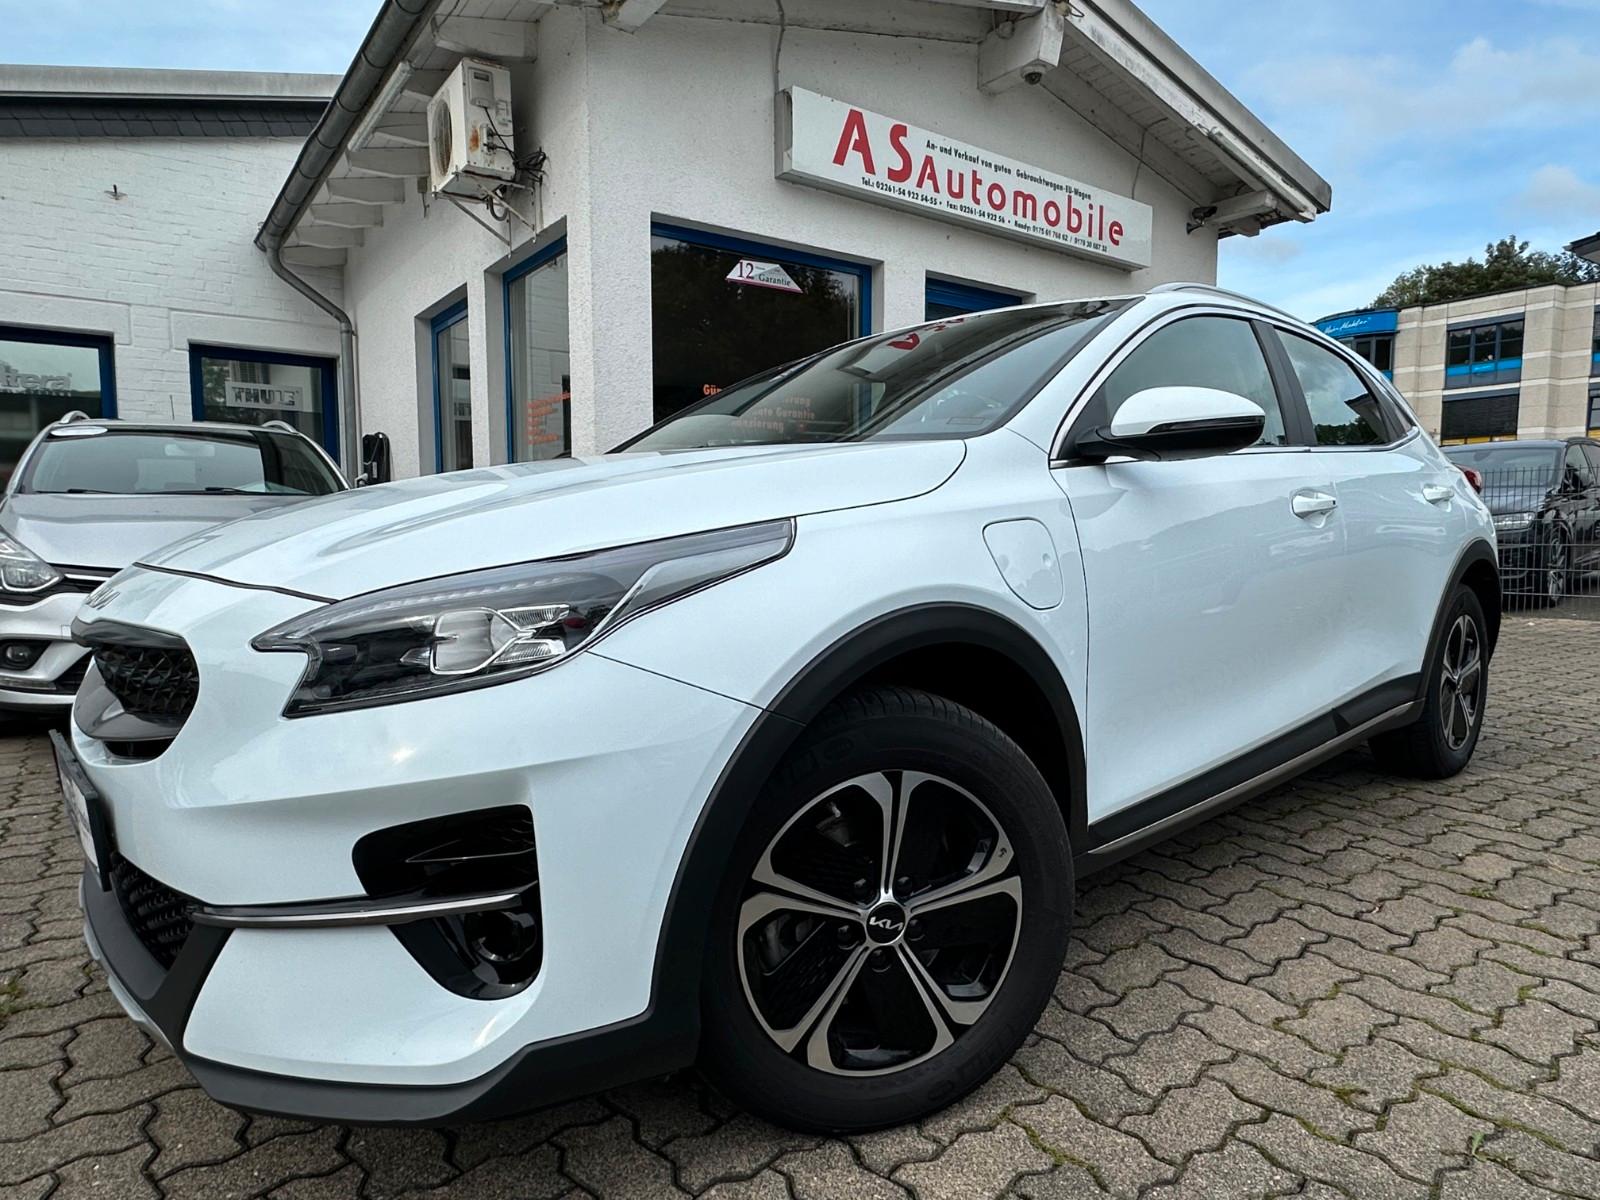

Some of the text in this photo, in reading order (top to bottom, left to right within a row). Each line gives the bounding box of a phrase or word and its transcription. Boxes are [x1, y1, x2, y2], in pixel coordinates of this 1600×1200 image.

[940, 145, 952, 155] und
[954, 148, 980, 164] Verkauf
[981, 159, 992, 169] von
[994, 163, 1012, 175] guten
[908, 190, 919, 200] 922
[738, 261, 754, 279] 12
[758, 273, 791, 287] Garantie
